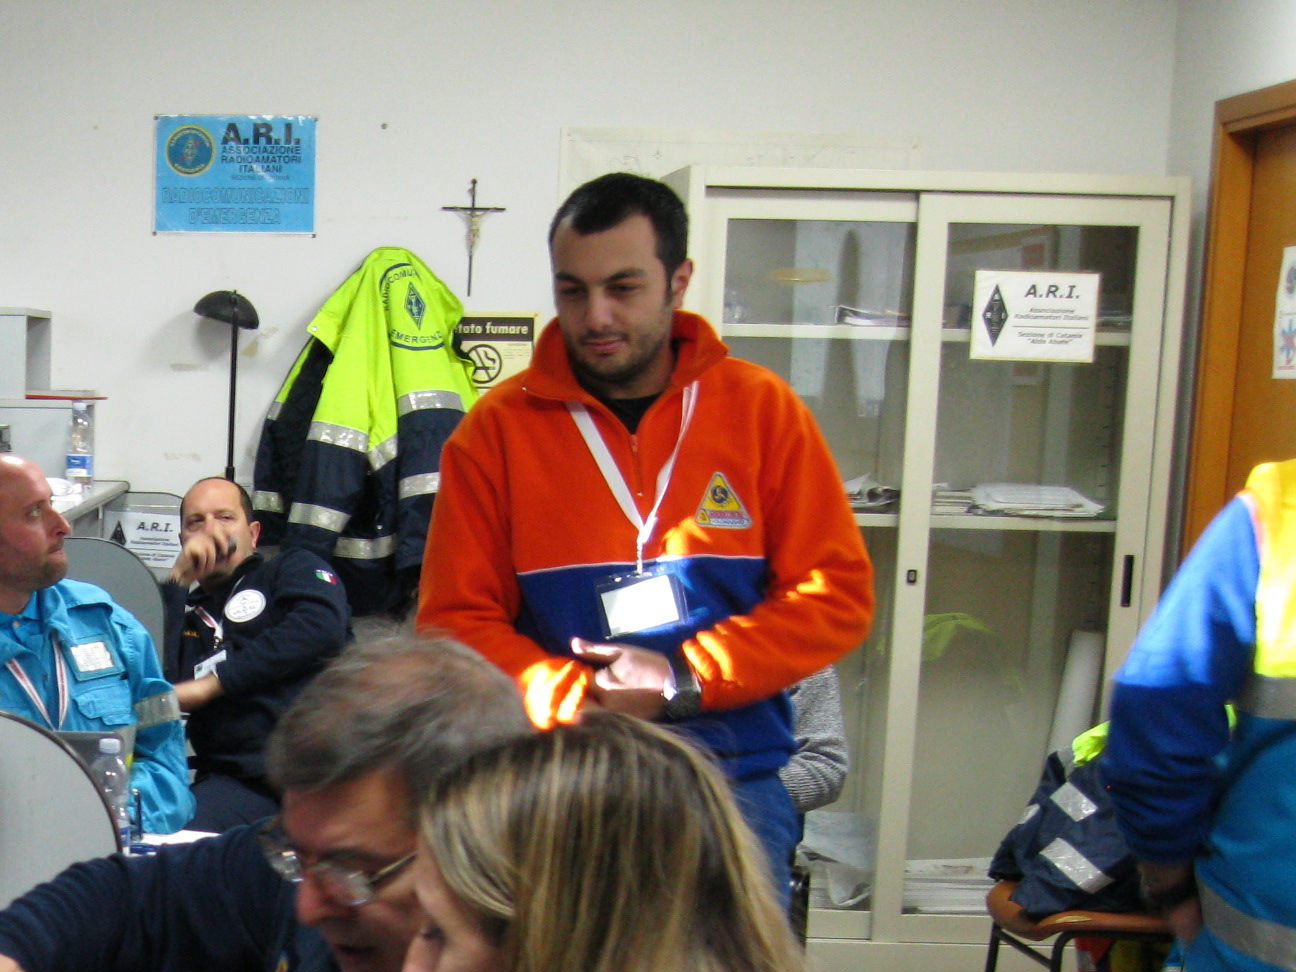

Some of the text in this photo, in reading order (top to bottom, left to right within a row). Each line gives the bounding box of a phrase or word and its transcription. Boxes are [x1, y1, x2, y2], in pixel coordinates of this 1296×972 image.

[221, 122, 301, 145] A.R.I.
[221, 146, 301, 154] ASSOCIAZIONE
[221, 155, 301, 163] RADIOAMATORI
[1024, 284, 1080, 299] A.R.I.
[456, 322, 528, 335] tato fumare
[136, 521, 173, 532] A.R.I.
